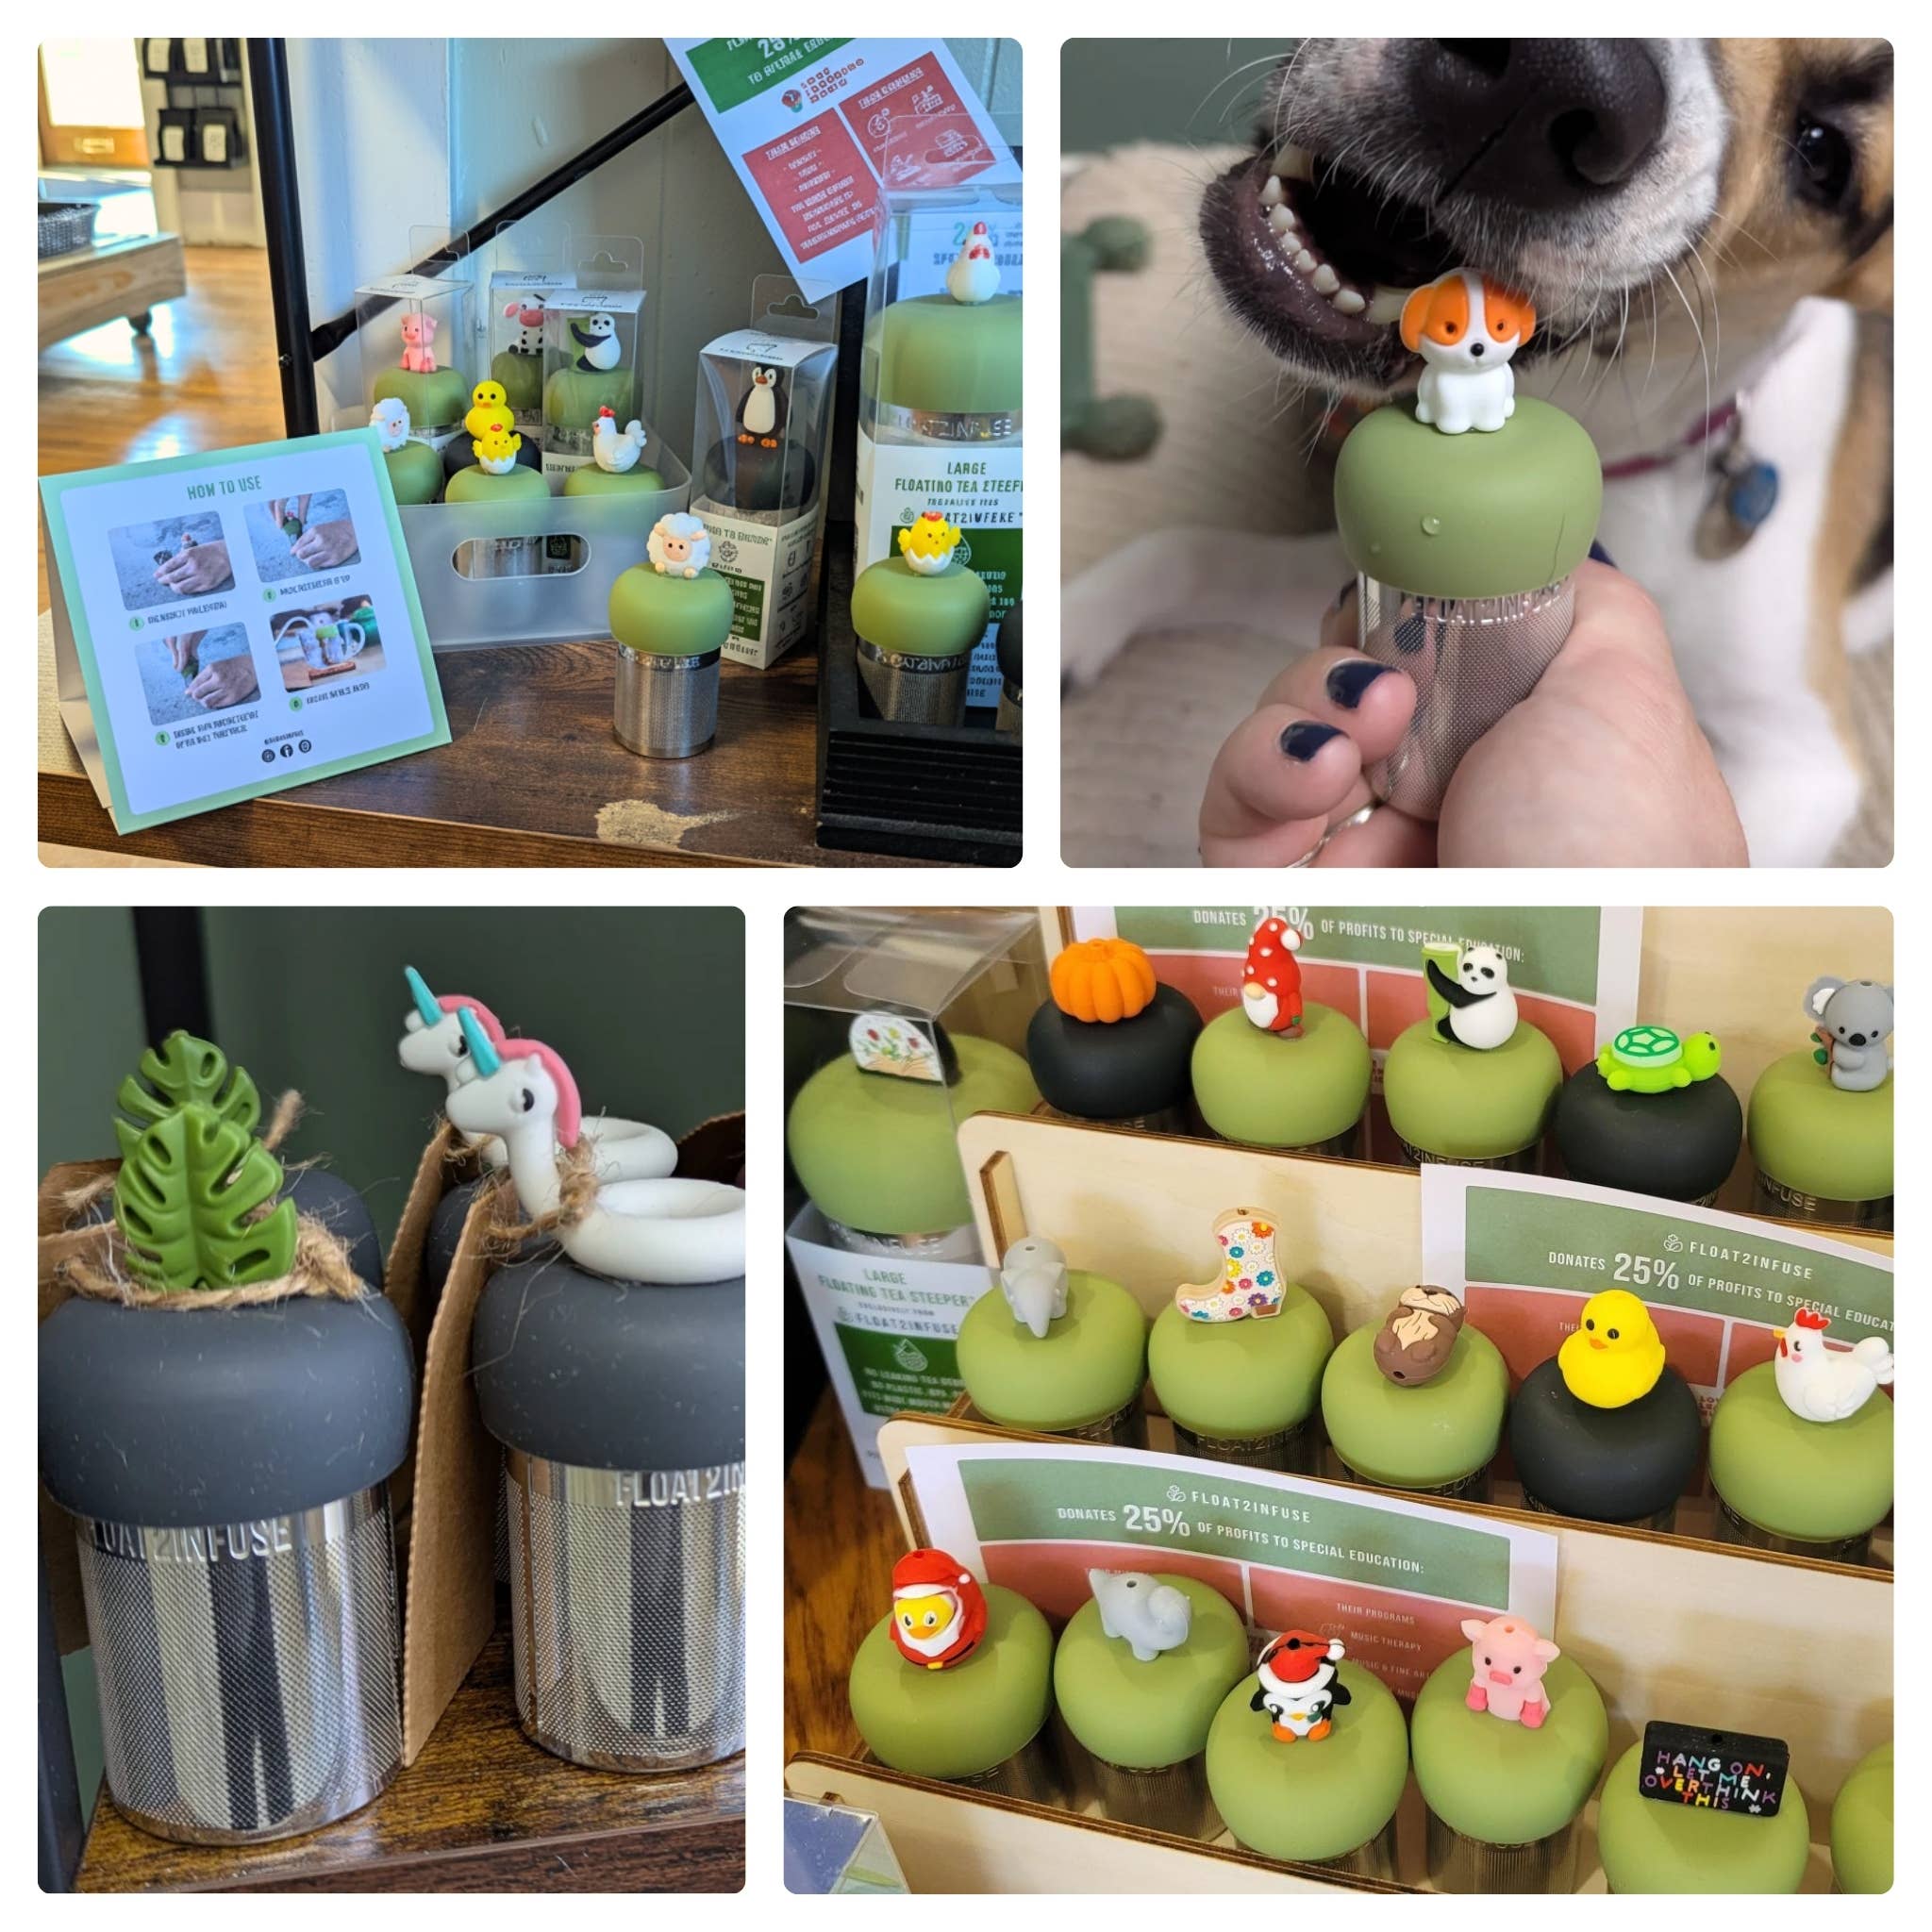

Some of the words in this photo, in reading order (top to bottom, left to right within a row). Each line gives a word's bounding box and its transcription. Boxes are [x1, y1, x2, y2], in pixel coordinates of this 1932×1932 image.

[947, 461, 987, 475] LARGE
[187, 482, 216, 501] HOW
[218, 479, 235, 495] TO
[238, 475, 262, 491] USE
[1193, 910, 1247, 926] DONATES
[1321, 919, 1336, 934] OF
[1339, 921, 1387, 941] PROFITS
[1390, 927, 1405, 942] TO
[1690, 1241, 1813, 1279] FLOAT2INFUSE
[818, 1275, 877, 1297] FLOATING
[881, 1286, 906, 1303] TEA
[863, 1268, 907, 1285] LARGE
[1548, 1251, 1606, 1271] DONATES
[1613, 1253, 1679, 1290] 25%
[1688, 1274, 1704, 1287] OF
[1707, 1277, 1762, 1299] PROFITS
[1767, 1290, 1783, 1304] TO
[1787, 1295, 1840, 1318] SPECIAL
[1191, 1491, 1311, 1523] FLOAT2INFUSE
[1058, 1507, 1116, 1522] DONATES
[1124, 1504, 1191, 1537] 25%
[1197, 1522, 1212, 1533] OF
[1217, 1524, 1269, 1544] PROFITS
[1274, 1535, 1289, 1548] TO
[1293, 1539, 1345, 1558] SPECIAL
[1349, 1550, 1424, 1574] EDUCATION:
[1337, 1603, 1362, 1614] THEIR
[1365, 1608, 1415, 1624] PROGRAMS
[1350, 1631, 1378, 1644] MUSIC
[1382, 1637, 1423, 1652] THERAPY
[1657, 1751, 1721, 1772] HANG
[1730, 1761, 1771, 1780] ON,
[1673, 1765, 1710, 1782] LET
[1719, 1773, 1750, 1789] ME
[1644, 1774, 1776, 1805] OVERTHINK
[1682, 1791, 1729, 1809] THIS
